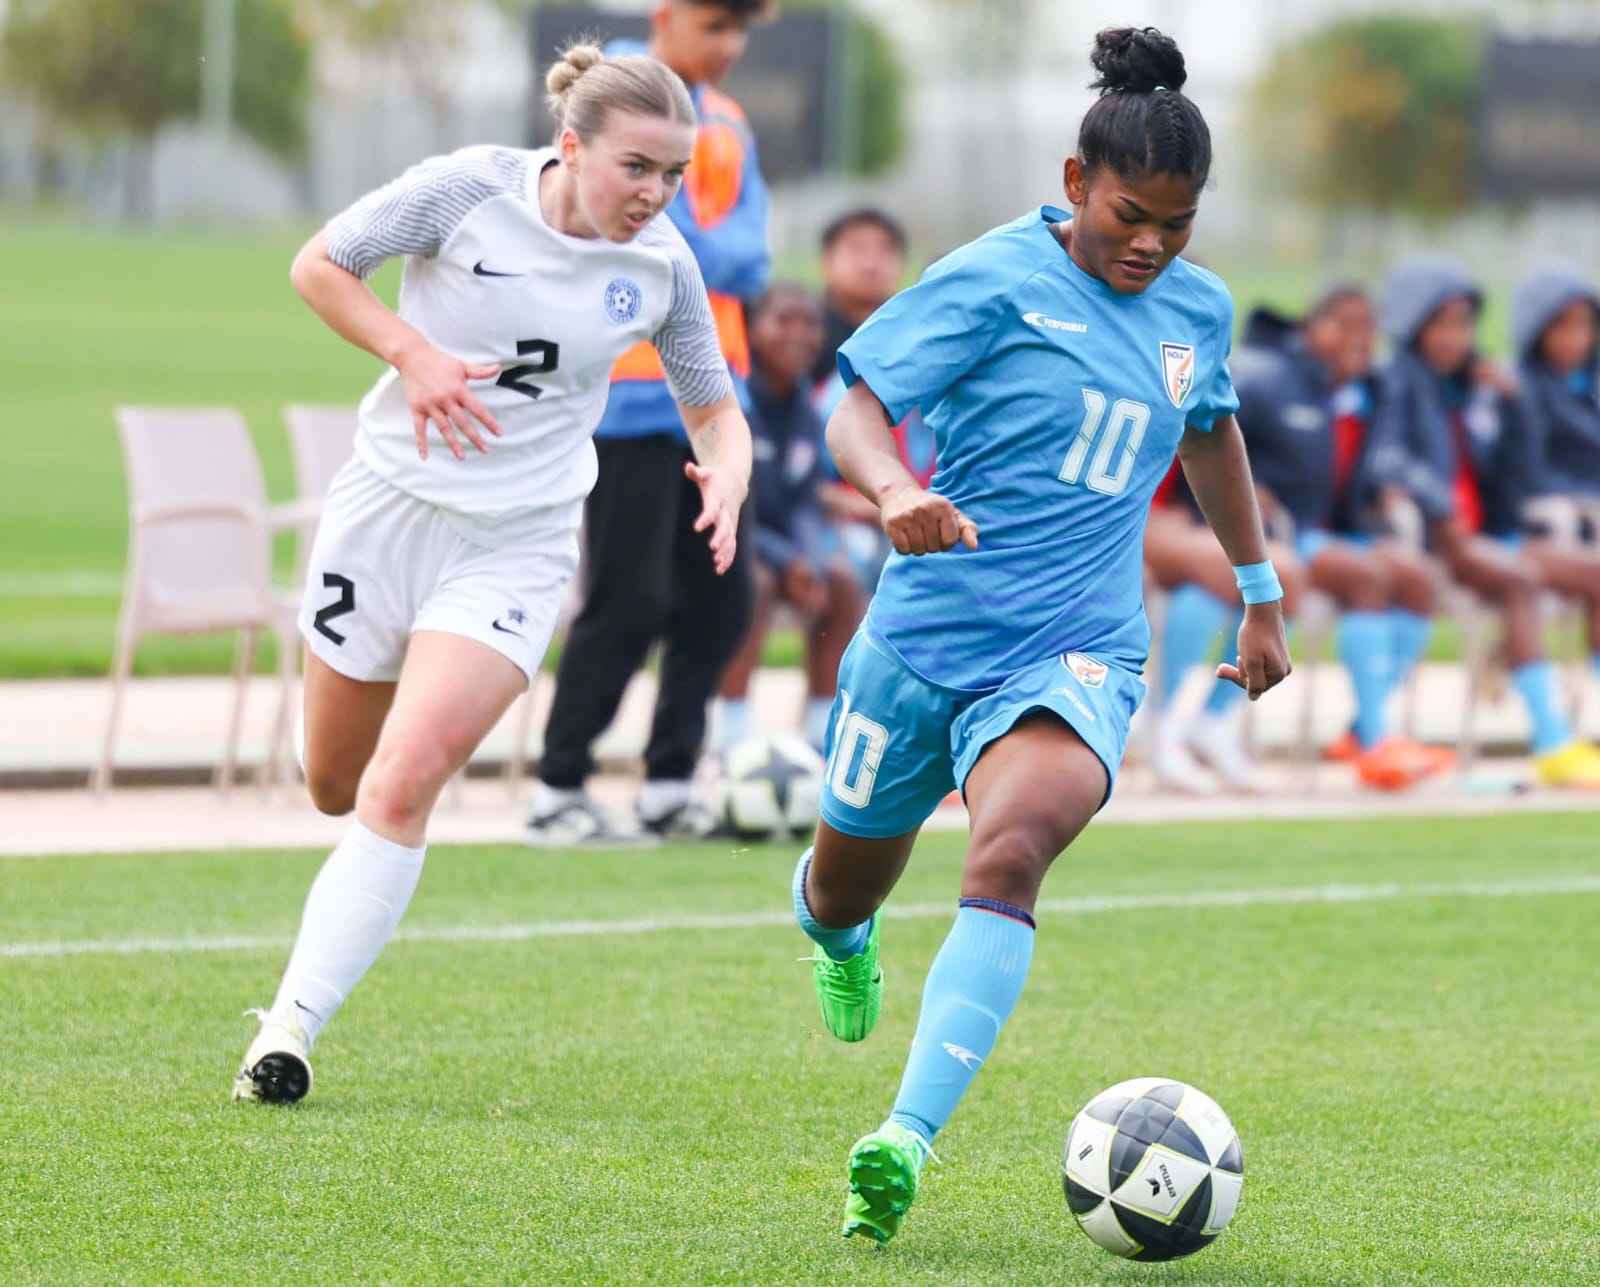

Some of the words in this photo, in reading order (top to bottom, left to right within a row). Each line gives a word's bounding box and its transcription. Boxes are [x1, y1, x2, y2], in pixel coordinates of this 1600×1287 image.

[495, 338, 559, 400] 2
[1167, 351, 1184, 360] INDIA
[1057, 387, 1151, 496] 10
[313, 572, 356, 646] 2
[826, 688, 889, 809] 10
[1159, 1163, 1176, 1198] erima
